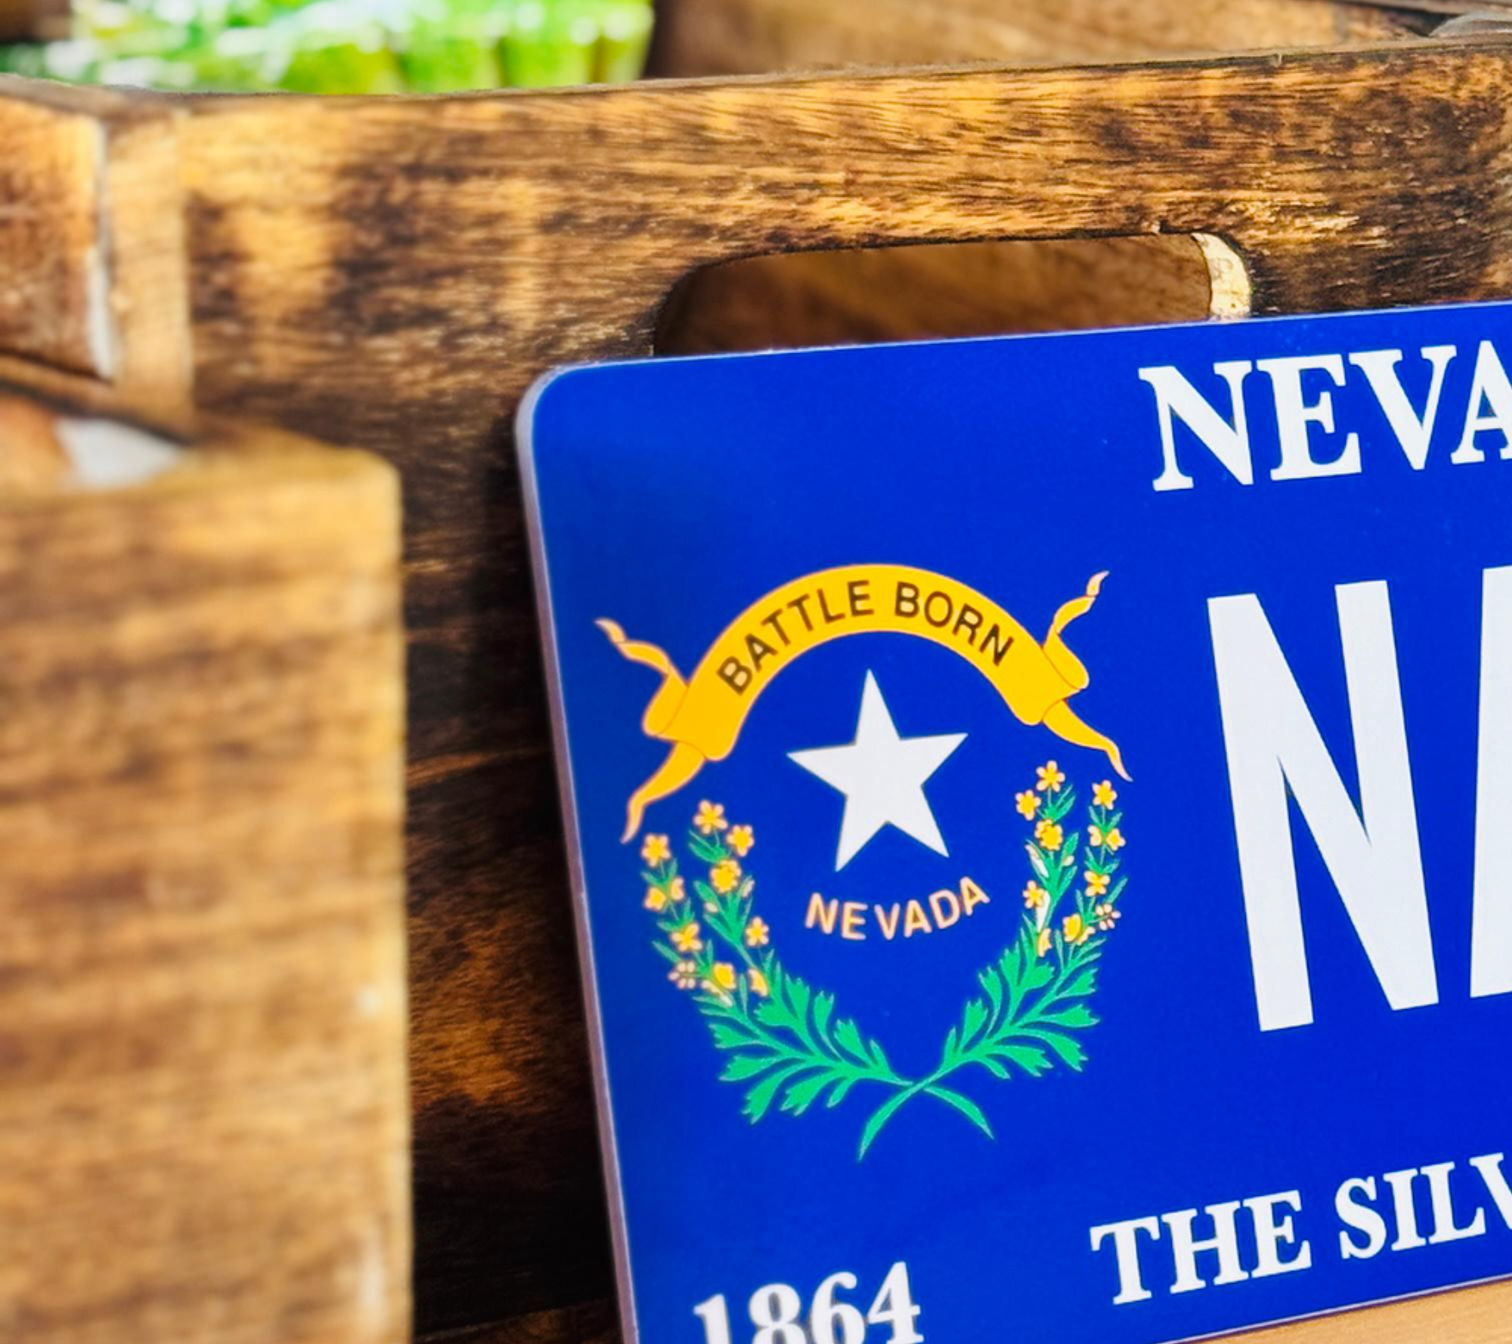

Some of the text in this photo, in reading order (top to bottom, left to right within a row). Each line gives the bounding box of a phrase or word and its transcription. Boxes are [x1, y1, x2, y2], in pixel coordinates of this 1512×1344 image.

[716, 580, 1016, 696] BATTLE BORN
[805, 876, 990, 941] NEVADA
[1089, 1190, 1312, 1305] THE
